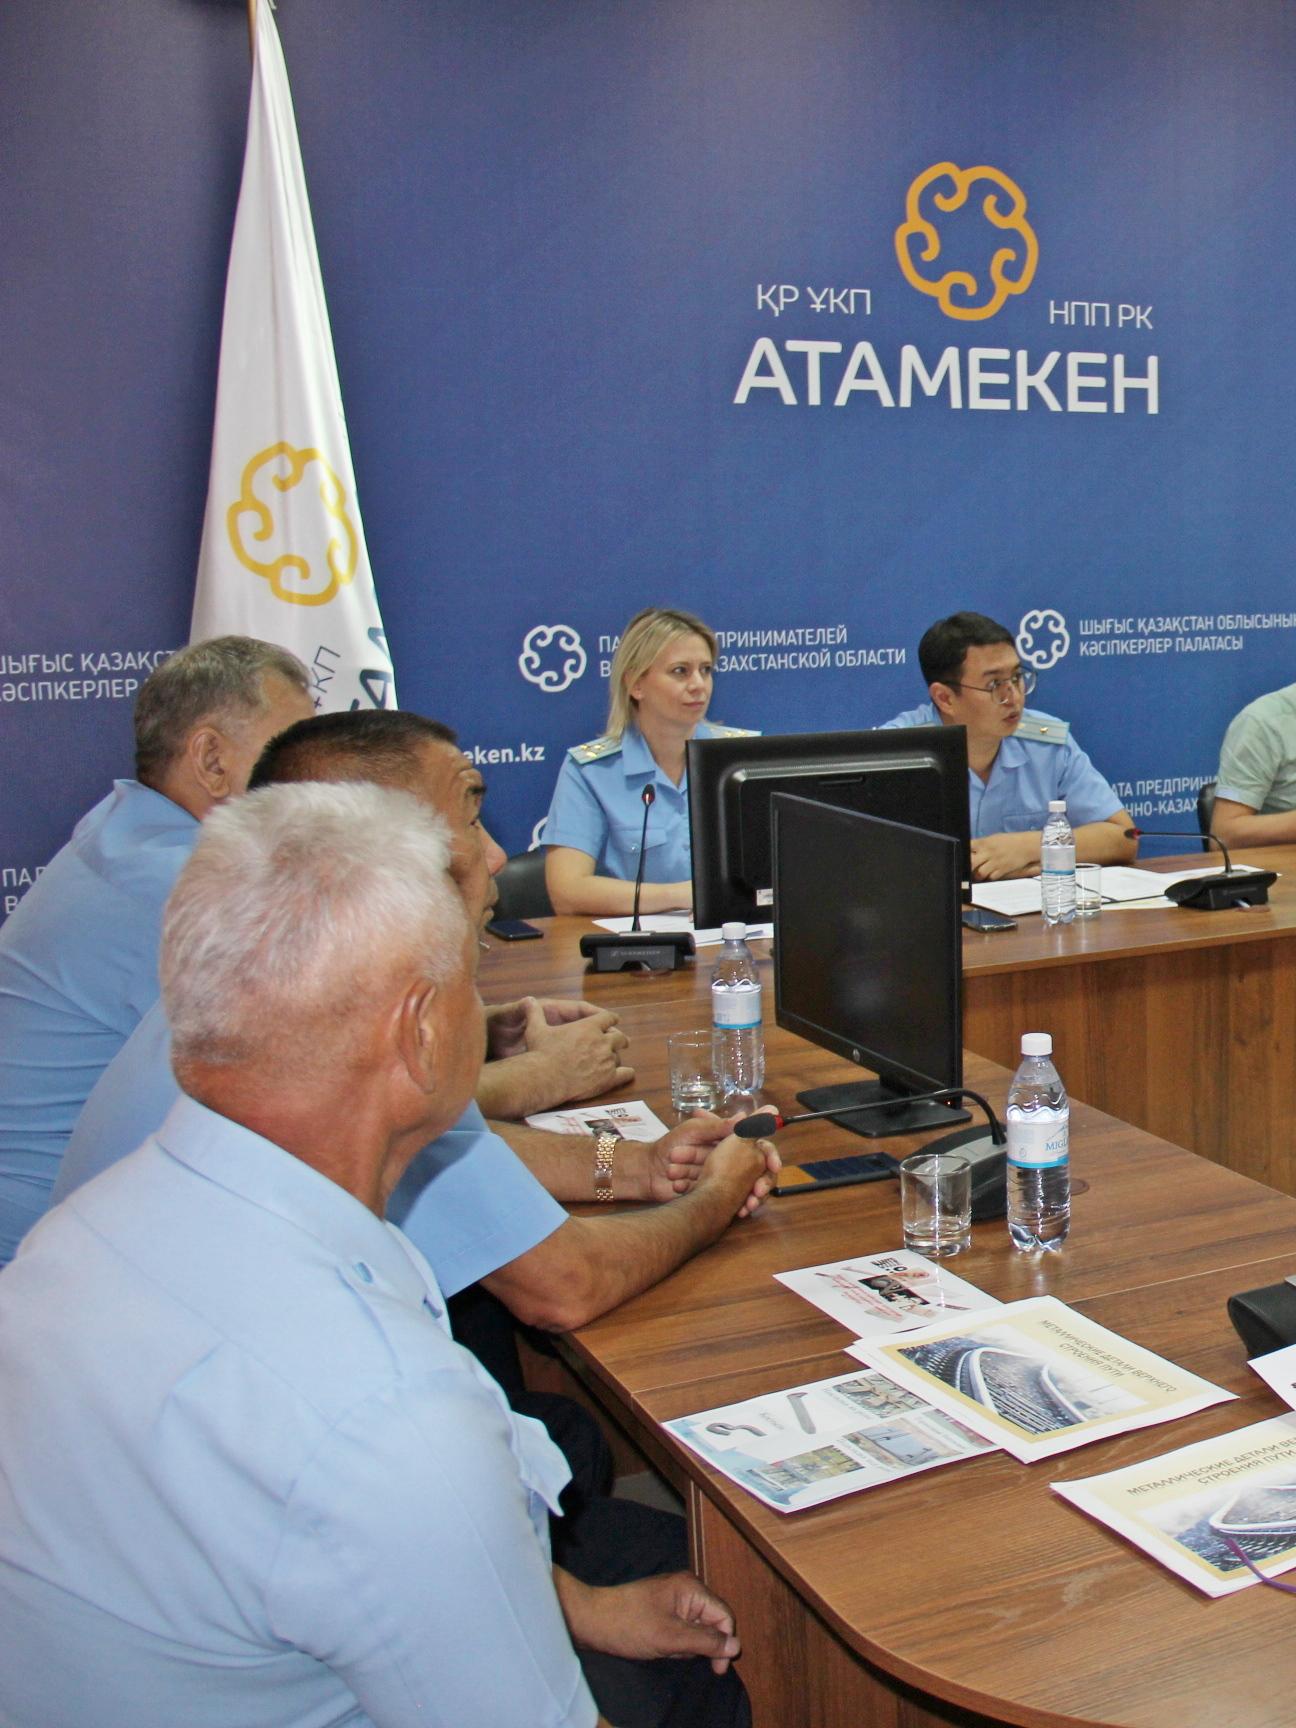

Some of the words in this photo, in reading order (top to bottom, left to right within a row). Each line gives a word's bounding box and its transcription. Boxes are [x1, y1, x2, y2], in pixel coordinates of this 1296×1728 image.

[755, 283, 800, 317] ҚР
[806, 286, 872, 316] ҰКП
[1049, 300, 1111, 327] НПП
[1117, 303, 1154, 330] РК
[733, 336, 1160, 415] АТАМЕКЕН
[715, 624, 848, 649] ПРИНИМАТЕЛЕЙ
[1078, 618, 1135, 636] ШЫҒЫС
[1137, 615, 1215, 636] ҚАЗАҚСТАН
[1079, 637, 1174, 657] КӘСІПКЕРЛЕР
[1175, 635, 1244, 652] ПАЛАТАСЫ
[80, 650, 176, 676] ҚАЗАҚС
[714, 648, 831, 673] ЗАХСТАНСКОЙ
[835, 648, 907, 668] ОБЛАСТИ
[0, 678, 139, 702] ӘСІПКЕРЛЕР
[462, 742, 546, 765] eken.kz
[1127, 1459, 1234, 1497] МЕТАЛЛИЧЕСКИЕ
[1233, 1443, 1280, 1468] ДЕТАЛИ
[1196, 1459, 1265, 1486] СТРОЕНИЯ
[1262, 1449, 1296, 1468] ПУТИ
